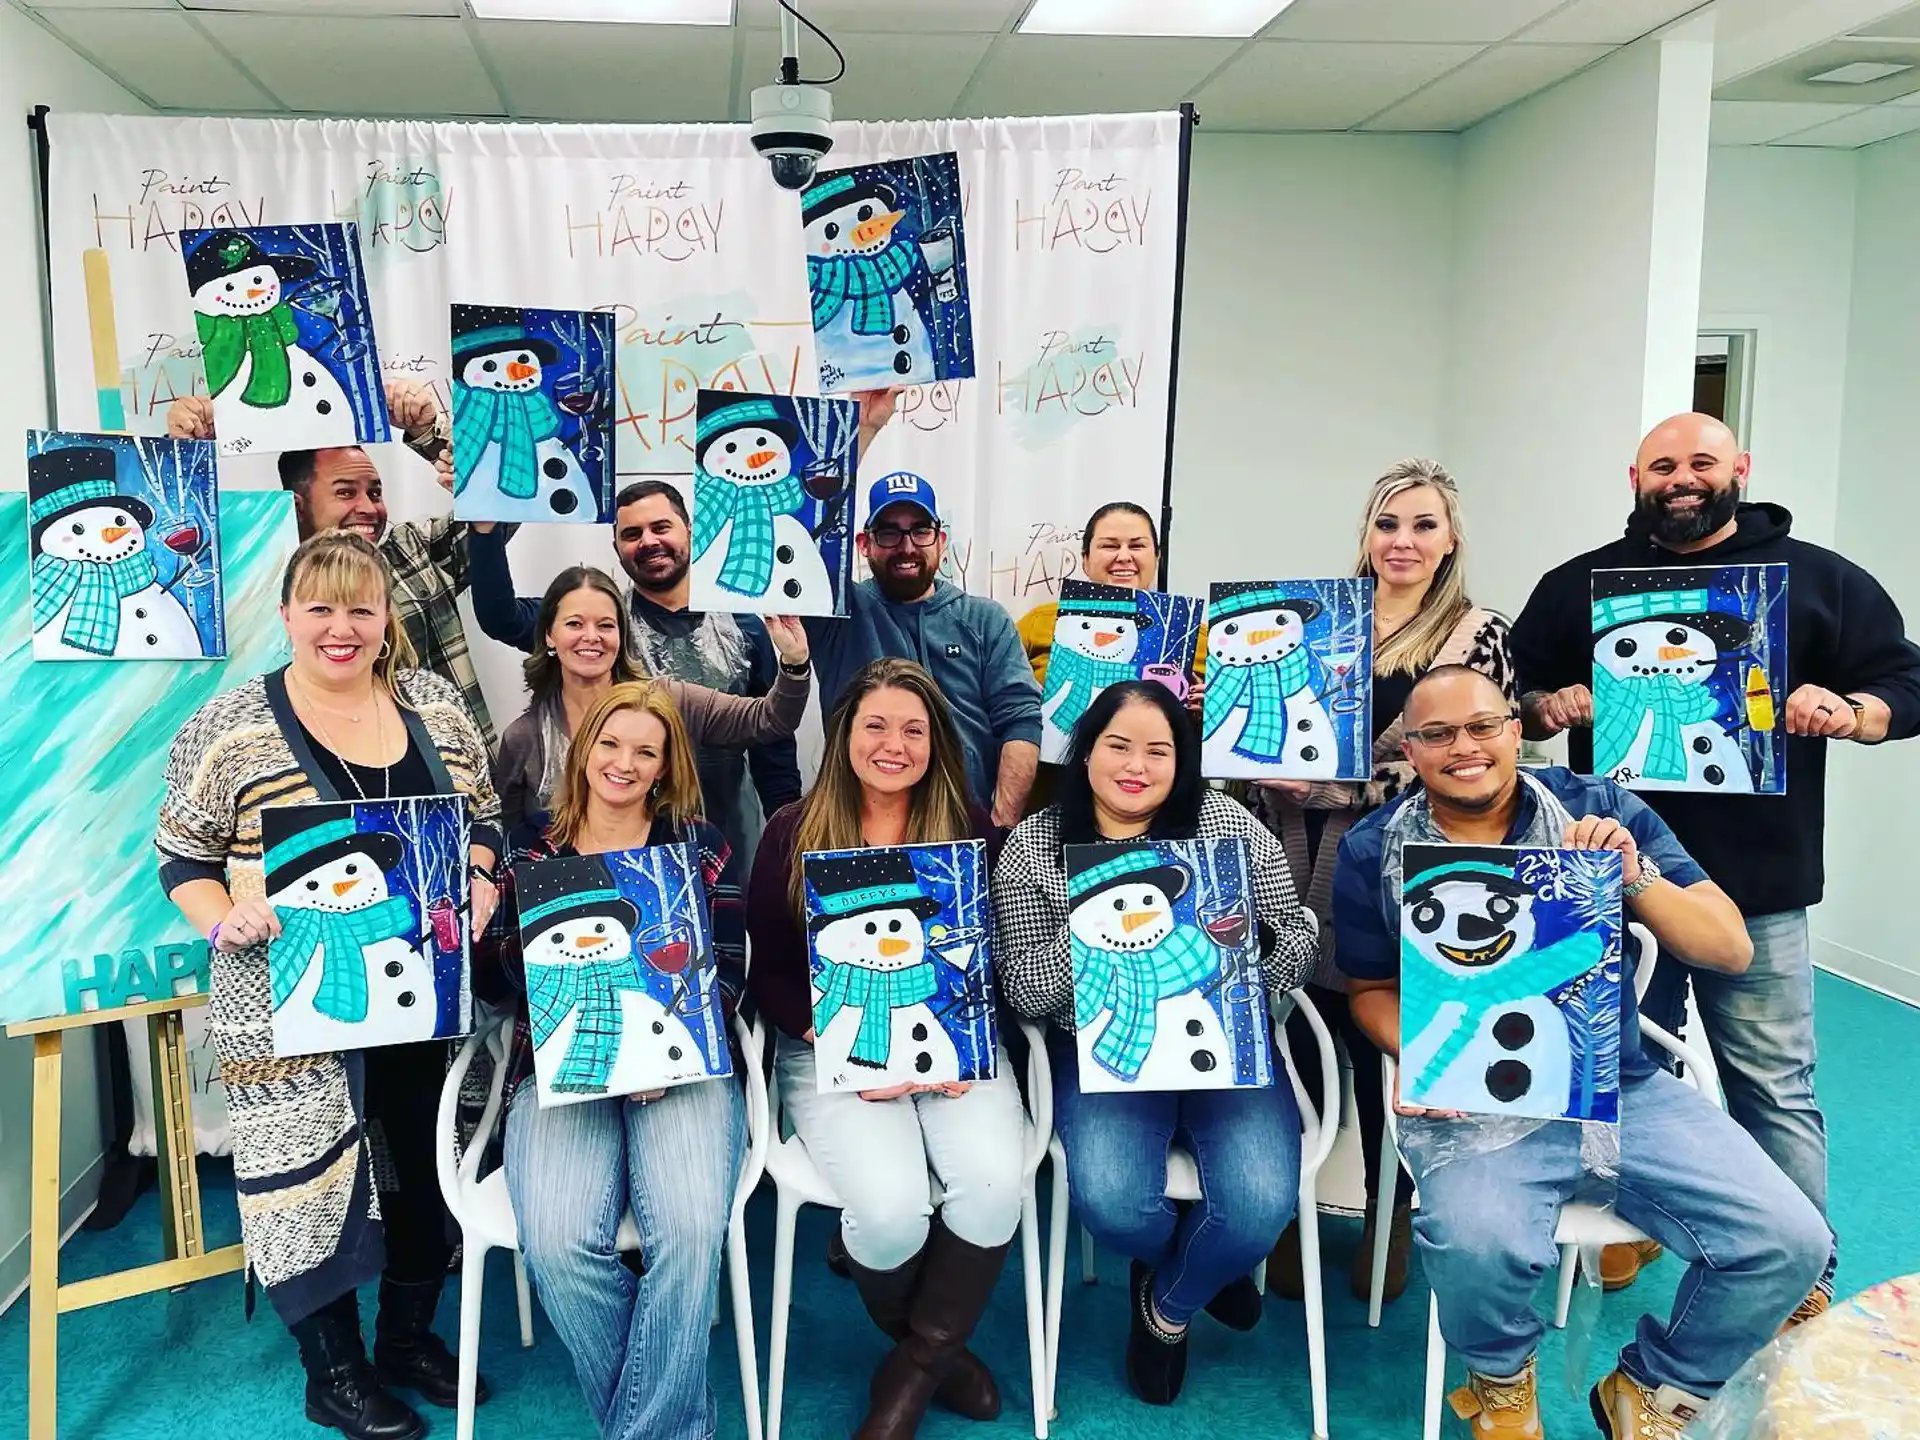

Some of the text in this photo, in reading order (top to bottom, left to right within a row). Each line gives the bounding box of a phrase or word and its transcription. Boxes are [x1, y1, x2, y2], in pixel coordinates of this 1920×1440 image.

[139, 168, 231, 205] Paint
[607, 174, 694, 212] Paint
[565, 198, 724, 260] HAPPY
